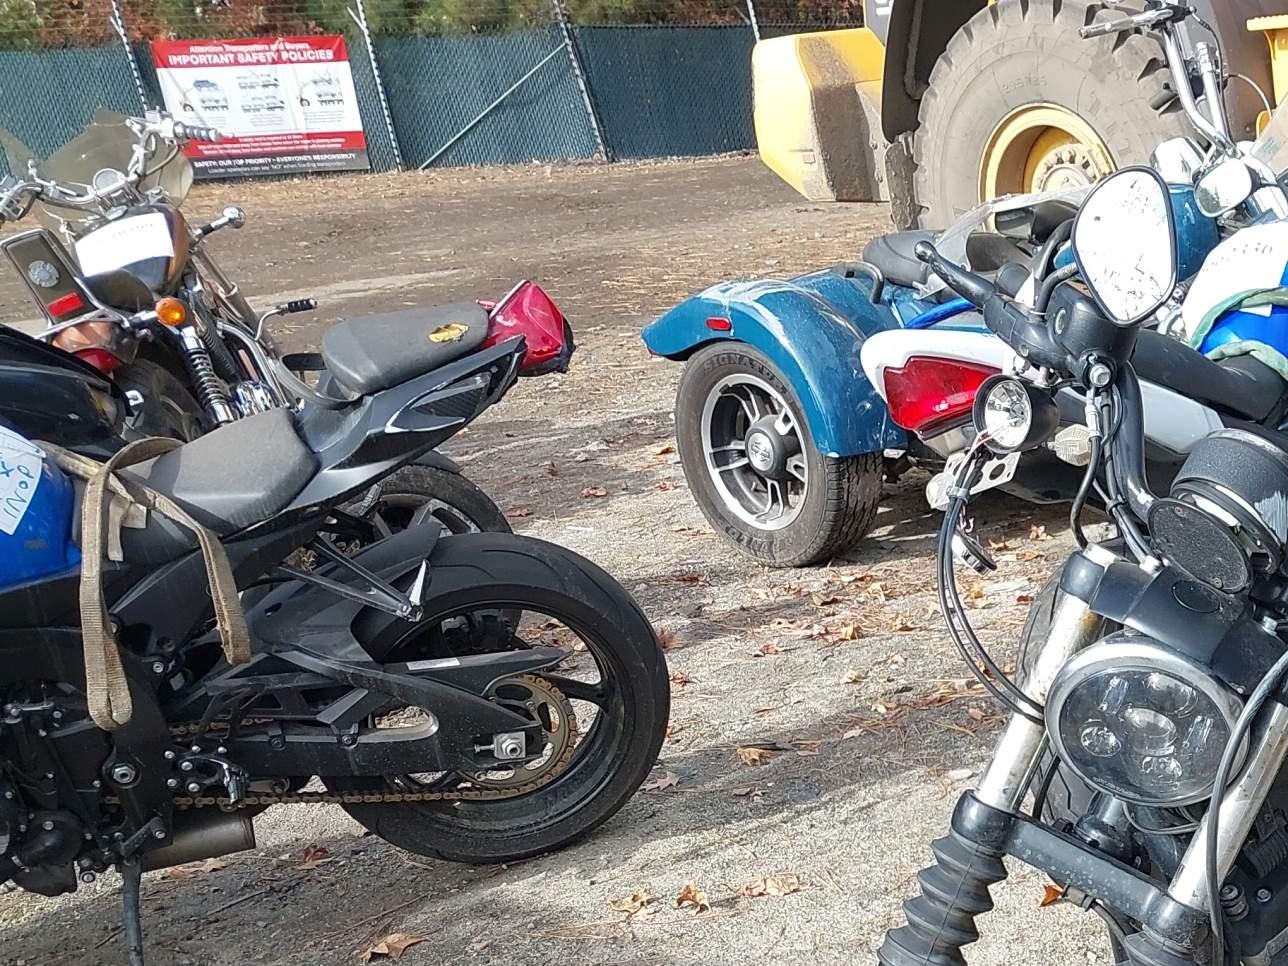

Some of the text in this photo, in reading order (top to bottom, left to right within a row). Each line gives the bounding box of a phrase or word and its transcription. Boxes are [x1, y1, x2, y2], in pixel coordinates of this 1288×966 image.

[168, 49, 334, 65] IMPORTANT SAFETY POLICIES
